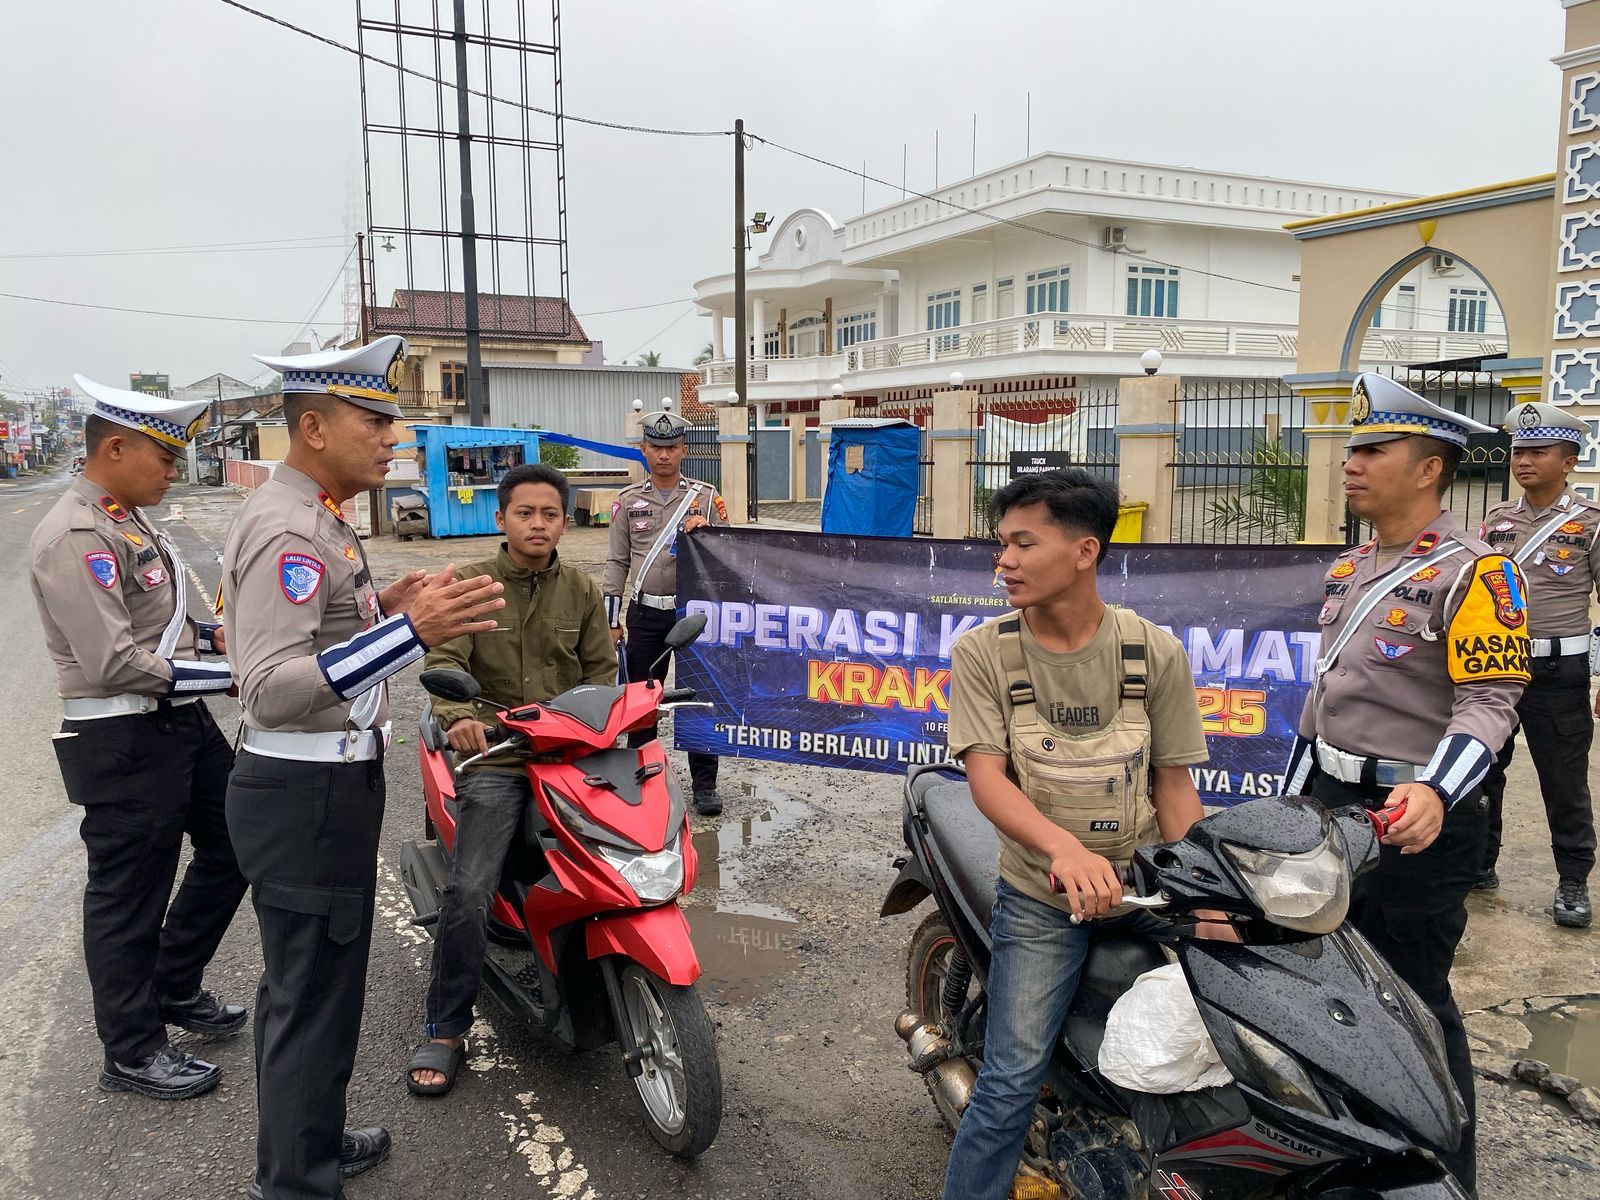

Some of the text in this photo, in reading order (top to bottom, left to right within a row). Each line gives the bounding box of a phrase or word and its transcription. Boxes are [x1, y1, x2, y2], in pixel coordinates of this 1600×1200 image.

[1031, 457, 1047, 465] TRUCK
[1548, 535, 1587, 547] POLRI
[285, 554, 302, 562] LALU
[931, 595, 972, 605] SATLANTAS
[974, 597, 1004, 607] POLRES
[686, 599, 919, 657] OPERASI
[1049, 706, 1100, 724] LEADER
[925, 722, 936, 732] 10
[799, 733, 889, 761] BERLALU
[1255, 1122, 1322, 1159] SUZUKI
